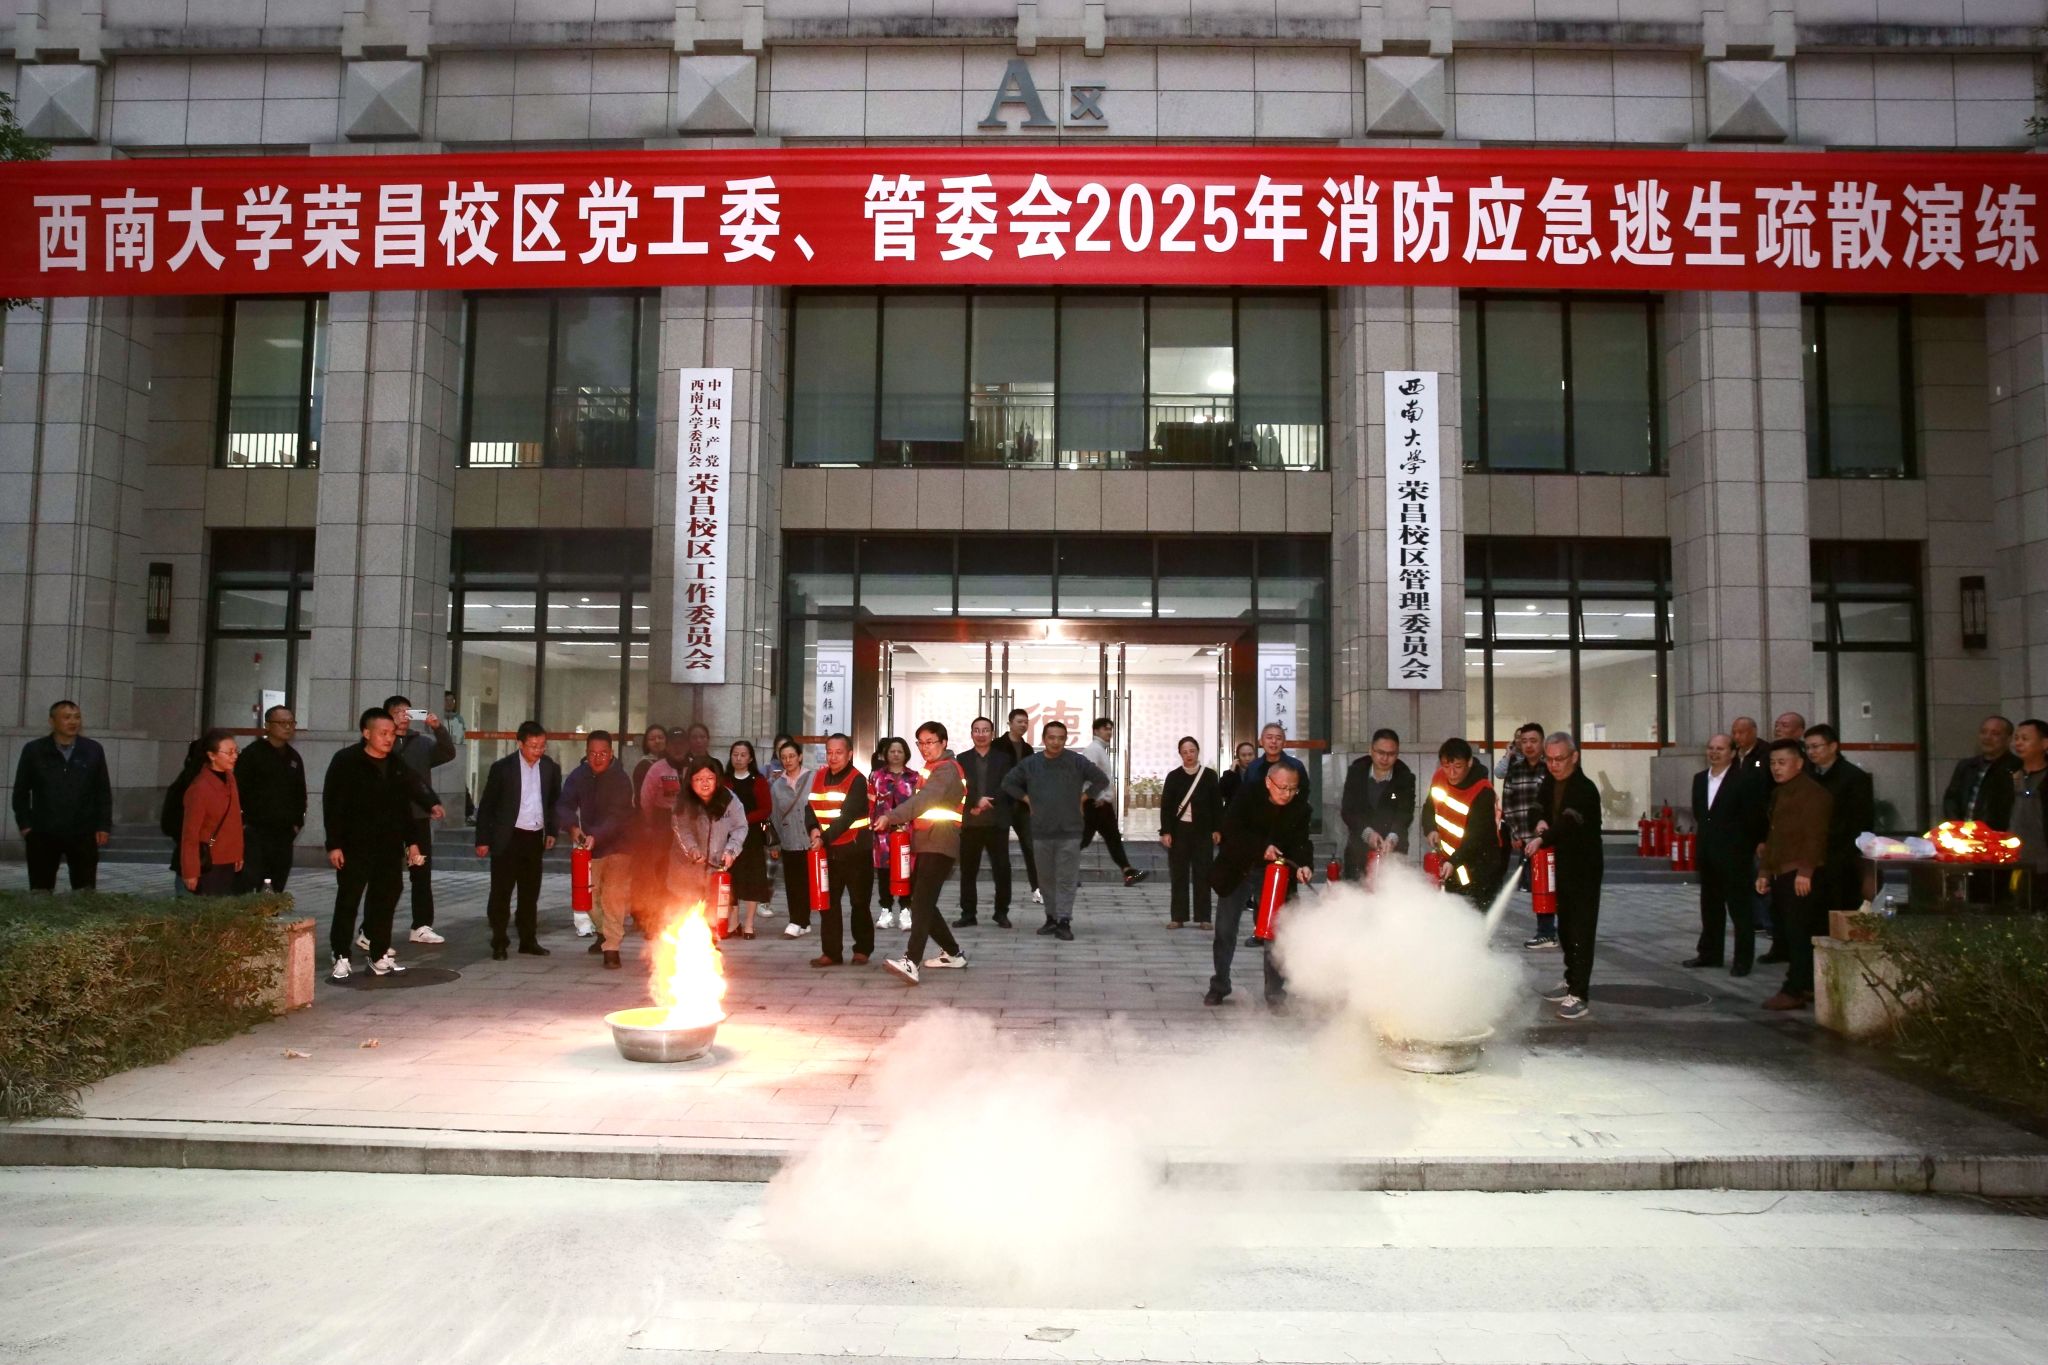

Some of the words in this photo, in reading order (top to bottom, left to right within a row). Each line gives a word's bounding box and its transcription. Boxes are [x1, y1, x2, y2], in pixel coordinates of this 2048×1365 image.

[977, 59, 1108, 128] A区
[33, 172, 2039, 273] 西南大学荣昌校区党工委、管委会2025年消防应急逃生疏散演练
[688, 378, 704, 468] 西南大学委员会
[704, 377, 722, 468] 中国共产党
[683, 472, 719, 671] 荣昌校区工作委员会
[1024, 699, 1083, 747] 德
